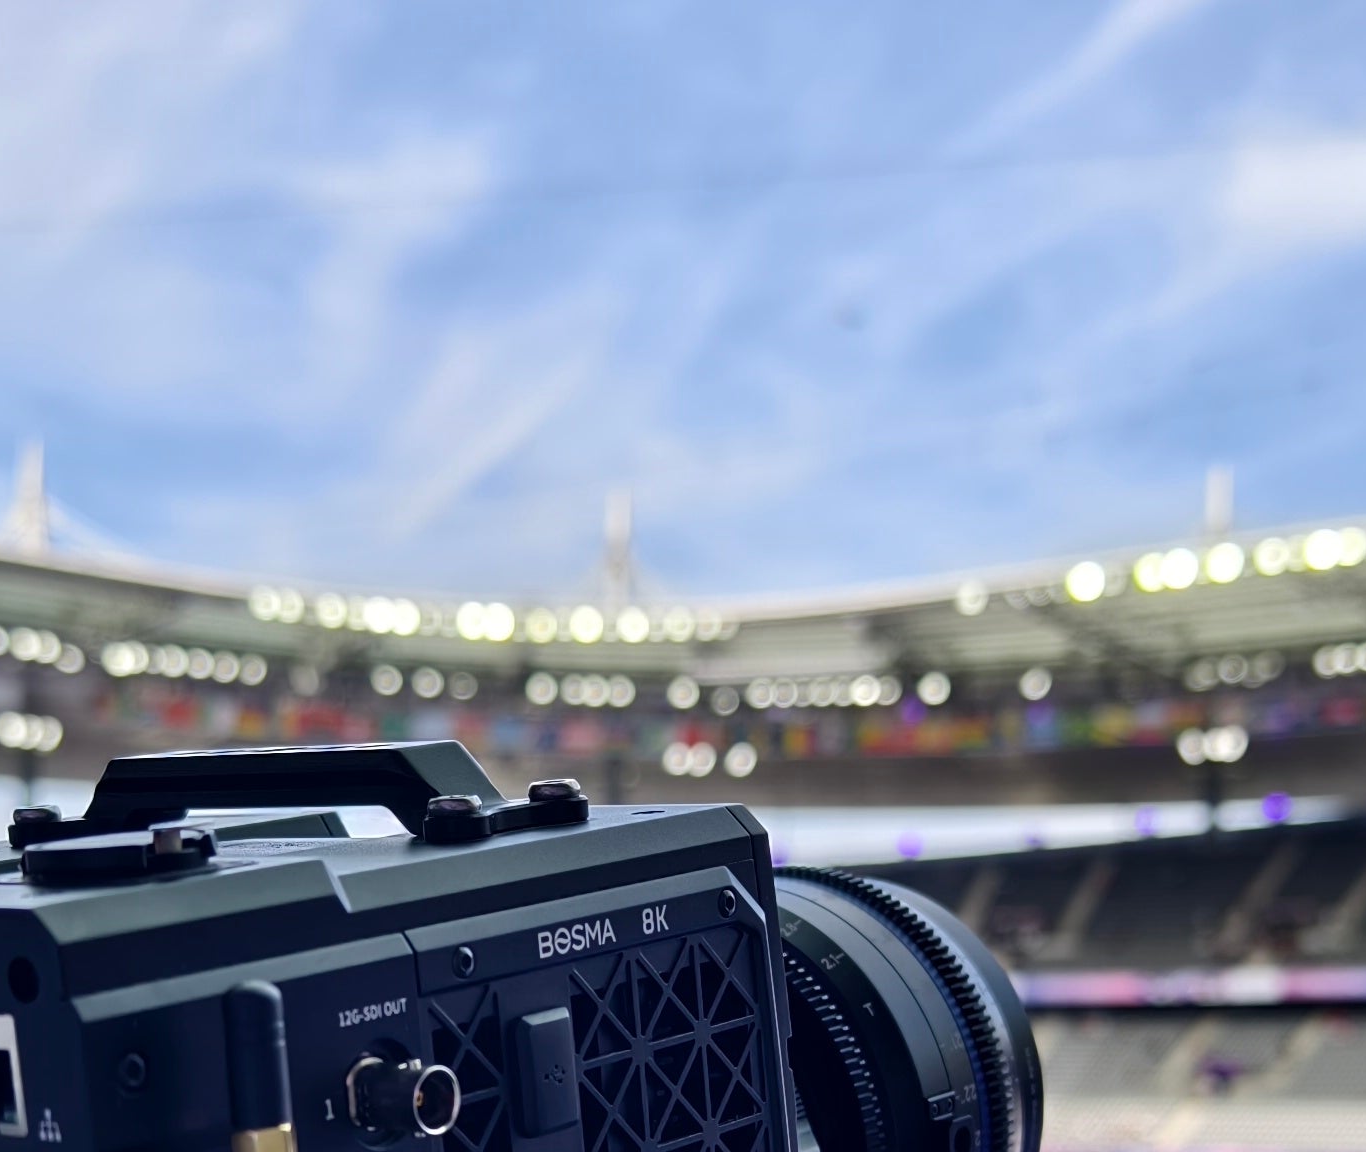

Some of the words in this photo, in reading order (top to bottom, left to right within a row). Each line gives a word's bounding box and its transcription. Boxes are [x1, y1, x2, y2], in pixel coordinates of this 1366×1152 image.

[537, 918, 616, 959] BOSMA
[642, 904, 669, 935] 8K
[338, 1003, 383, 1028] 12G-SDI
[383, 997, 407, 1017] OUT
[325, 1099, 334, 1120] 1
